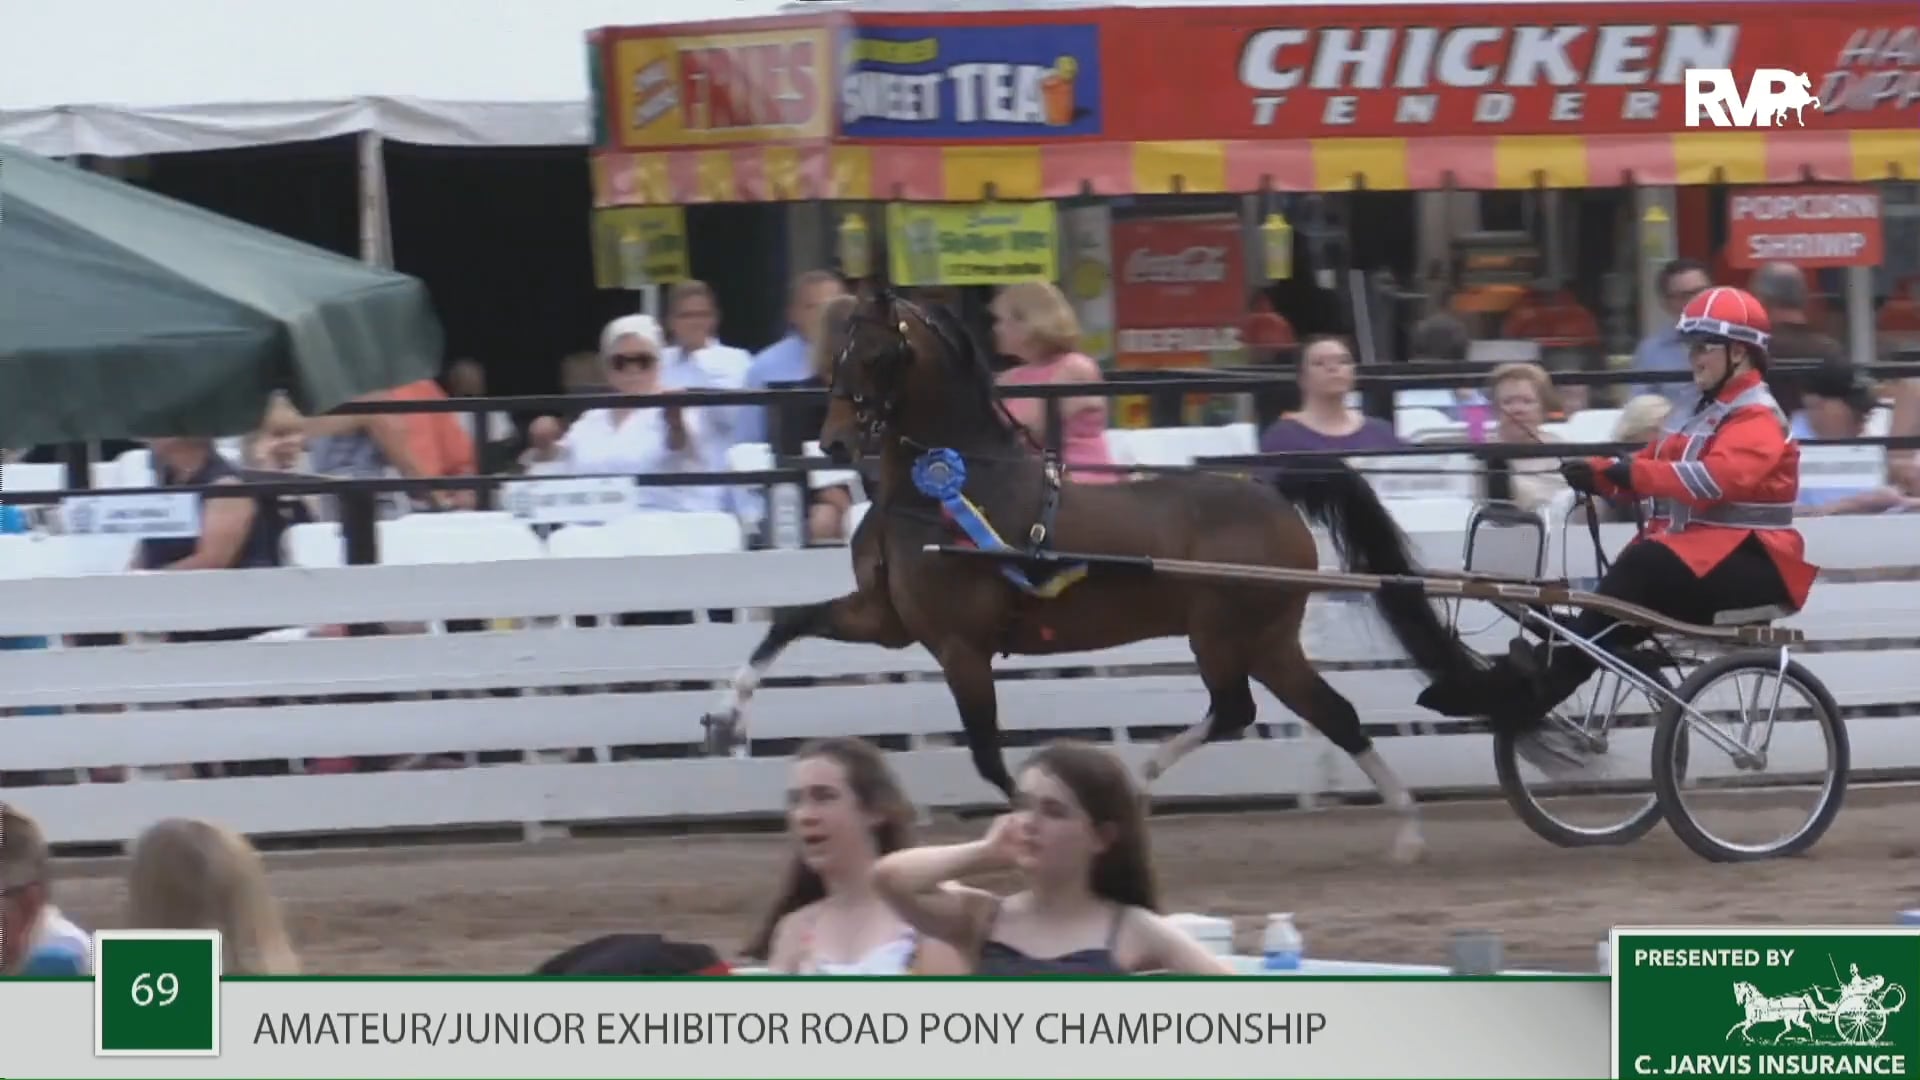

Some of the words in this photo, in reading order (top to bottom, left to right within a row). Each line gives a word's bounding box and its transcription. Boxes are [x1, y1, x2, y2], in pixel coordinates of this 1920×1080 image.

[1239, 25, 1738, 88] CHICKEN
[842, 71, 944, 125] SWEET
[947, 62, 1046, 123] TEA
[1252, 92, 1728, 126] TENDER
[1731, 193, 1880, 220] POPCORN
[1748, 231, 1866, 259] SHRIMP
